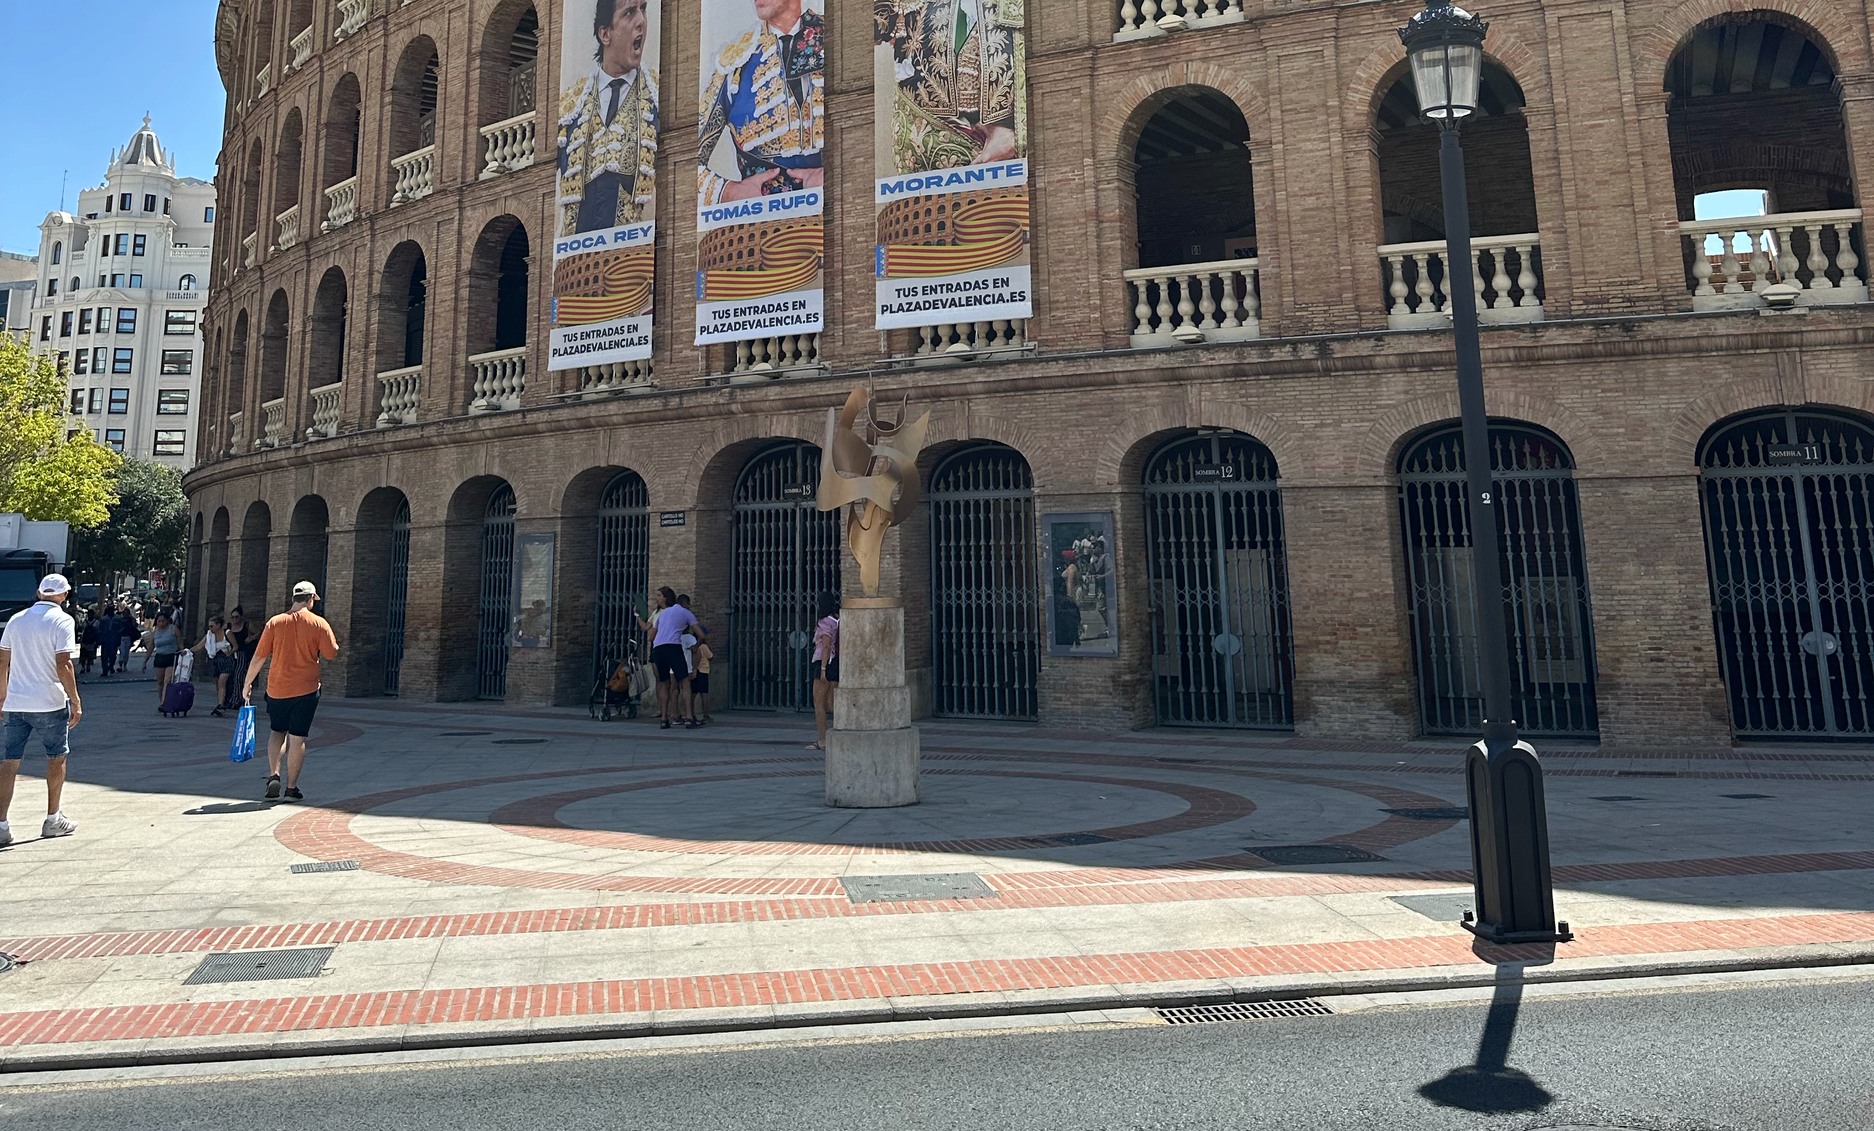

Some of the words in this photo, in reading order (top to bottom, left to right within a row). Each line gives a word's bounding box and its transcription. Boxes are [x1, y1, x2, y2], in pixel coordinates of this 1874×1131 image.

[880, 163, 1024, 196] MORANTE
[701, 200, 763, 223] TOMÁS
[768, 192, 819, 212] RUFO
[556, 234, 607, 254] ROCA
[614, 225, 653, 244] REY
[895, 286, 918, 298] TUS
[921, 279, 989, 296] ENTRADAS
[992, 276, 1010, 288] EN
[712, 309, 731, 320] TUS
[733, 301, 789, 318] ENTRADAS
[792, 299, 806, 310] EN
[881, 290, 1026, 315] PLAZADEVALENCIA.ES
[563, 333, 578, 343] TUS
[580, 325, 625, 341] ENTRADAS
[627, 323, 639, 333] EN
[699, 312, 820, 336] PLAZADEVALENCIA.ES
[552, 335, 649, 357] PLAZADEVALENCIA.ES
[1769, 450, 1802, 458] SOMBRA
[1804, 445, 1819, 460] 11
[1220, 465, 1234, 478] 12
[1481, 492, 1491, 504] 2
